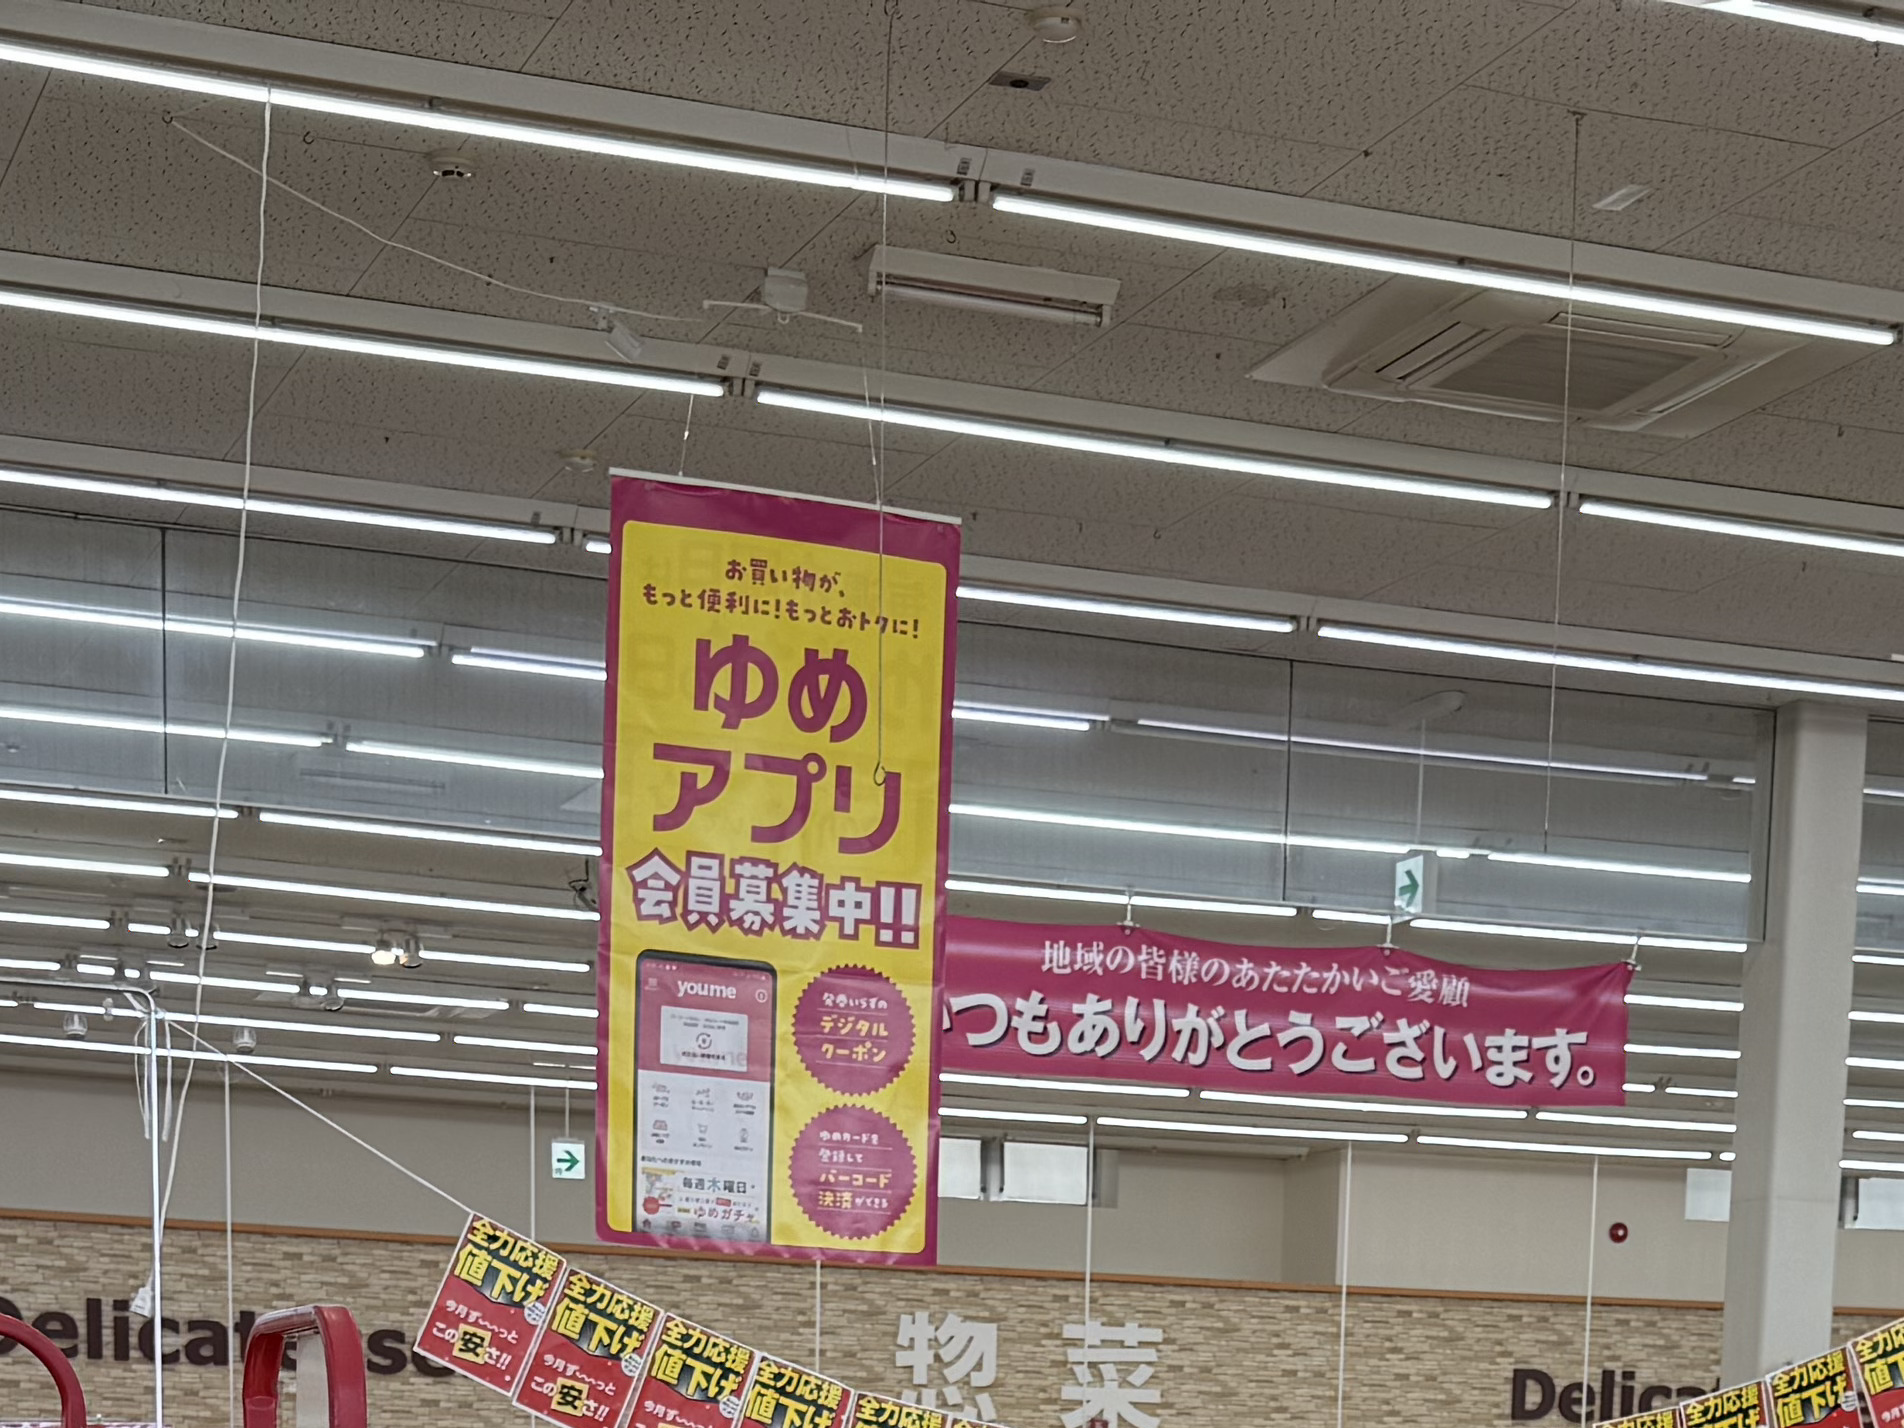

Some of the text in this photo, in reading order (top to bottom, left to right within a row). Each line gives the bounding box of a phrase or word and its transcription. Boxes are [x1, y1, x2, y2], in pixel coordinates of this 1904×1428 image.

[725, 558, 846, 597] お買い物が、
[694, 634, 867, 743] ゆめ
[653, 742, 901, 854] アプリ
[629, 851, 921, 948] 会員募集中!!
[677, 980, 737, 1000] youme
[1040, 940, 1470, 1008] 地域の皆様のあたたかいご愛顧
[821, 1015, 888, 1037] デジタル
[821, 1044, 888, 1063] クーポン
[818, 1172, 892, 1188] バーコード
[1771, 1350, 1846, 1396] 全力応援
[1775, 1379, 1849, 1428] 値下げ
